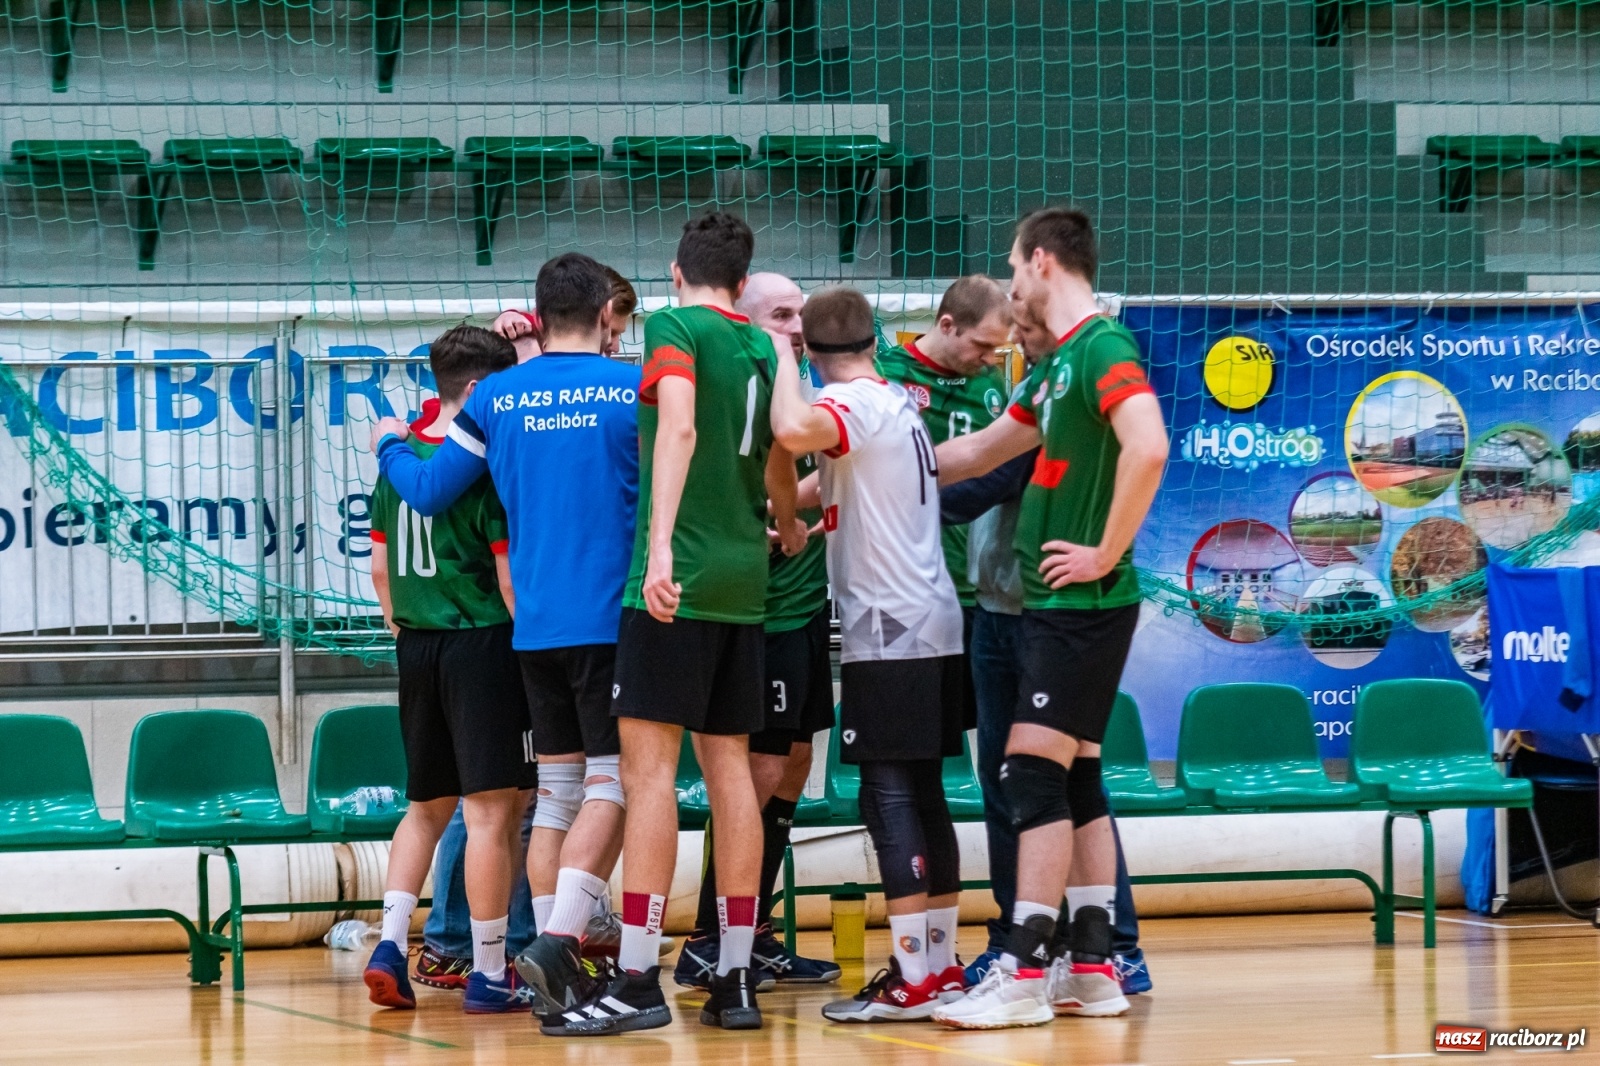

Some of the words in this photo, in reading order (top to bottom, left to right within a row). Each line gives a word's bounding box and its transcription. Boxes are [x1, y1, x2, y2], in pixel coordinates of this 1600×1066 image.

[1306, 333, 1415, 357] Ośrodek
[1422, 333, 1506, 360] Sportu
[1512, 335, 1521, 356] i
[1490, 374, 1514, 391] w
[493, 394, 515, 414] KS
[518, 391, 553, 409] AZS
[558, 386, 636, 405] RAFAKO
[524, 411, 598, 432] Racibórz
[772, 680, 787, 712] 3
[646, 901, 662, 935] KIPSTA
[717, 903, 728, 935] KIPSTA
